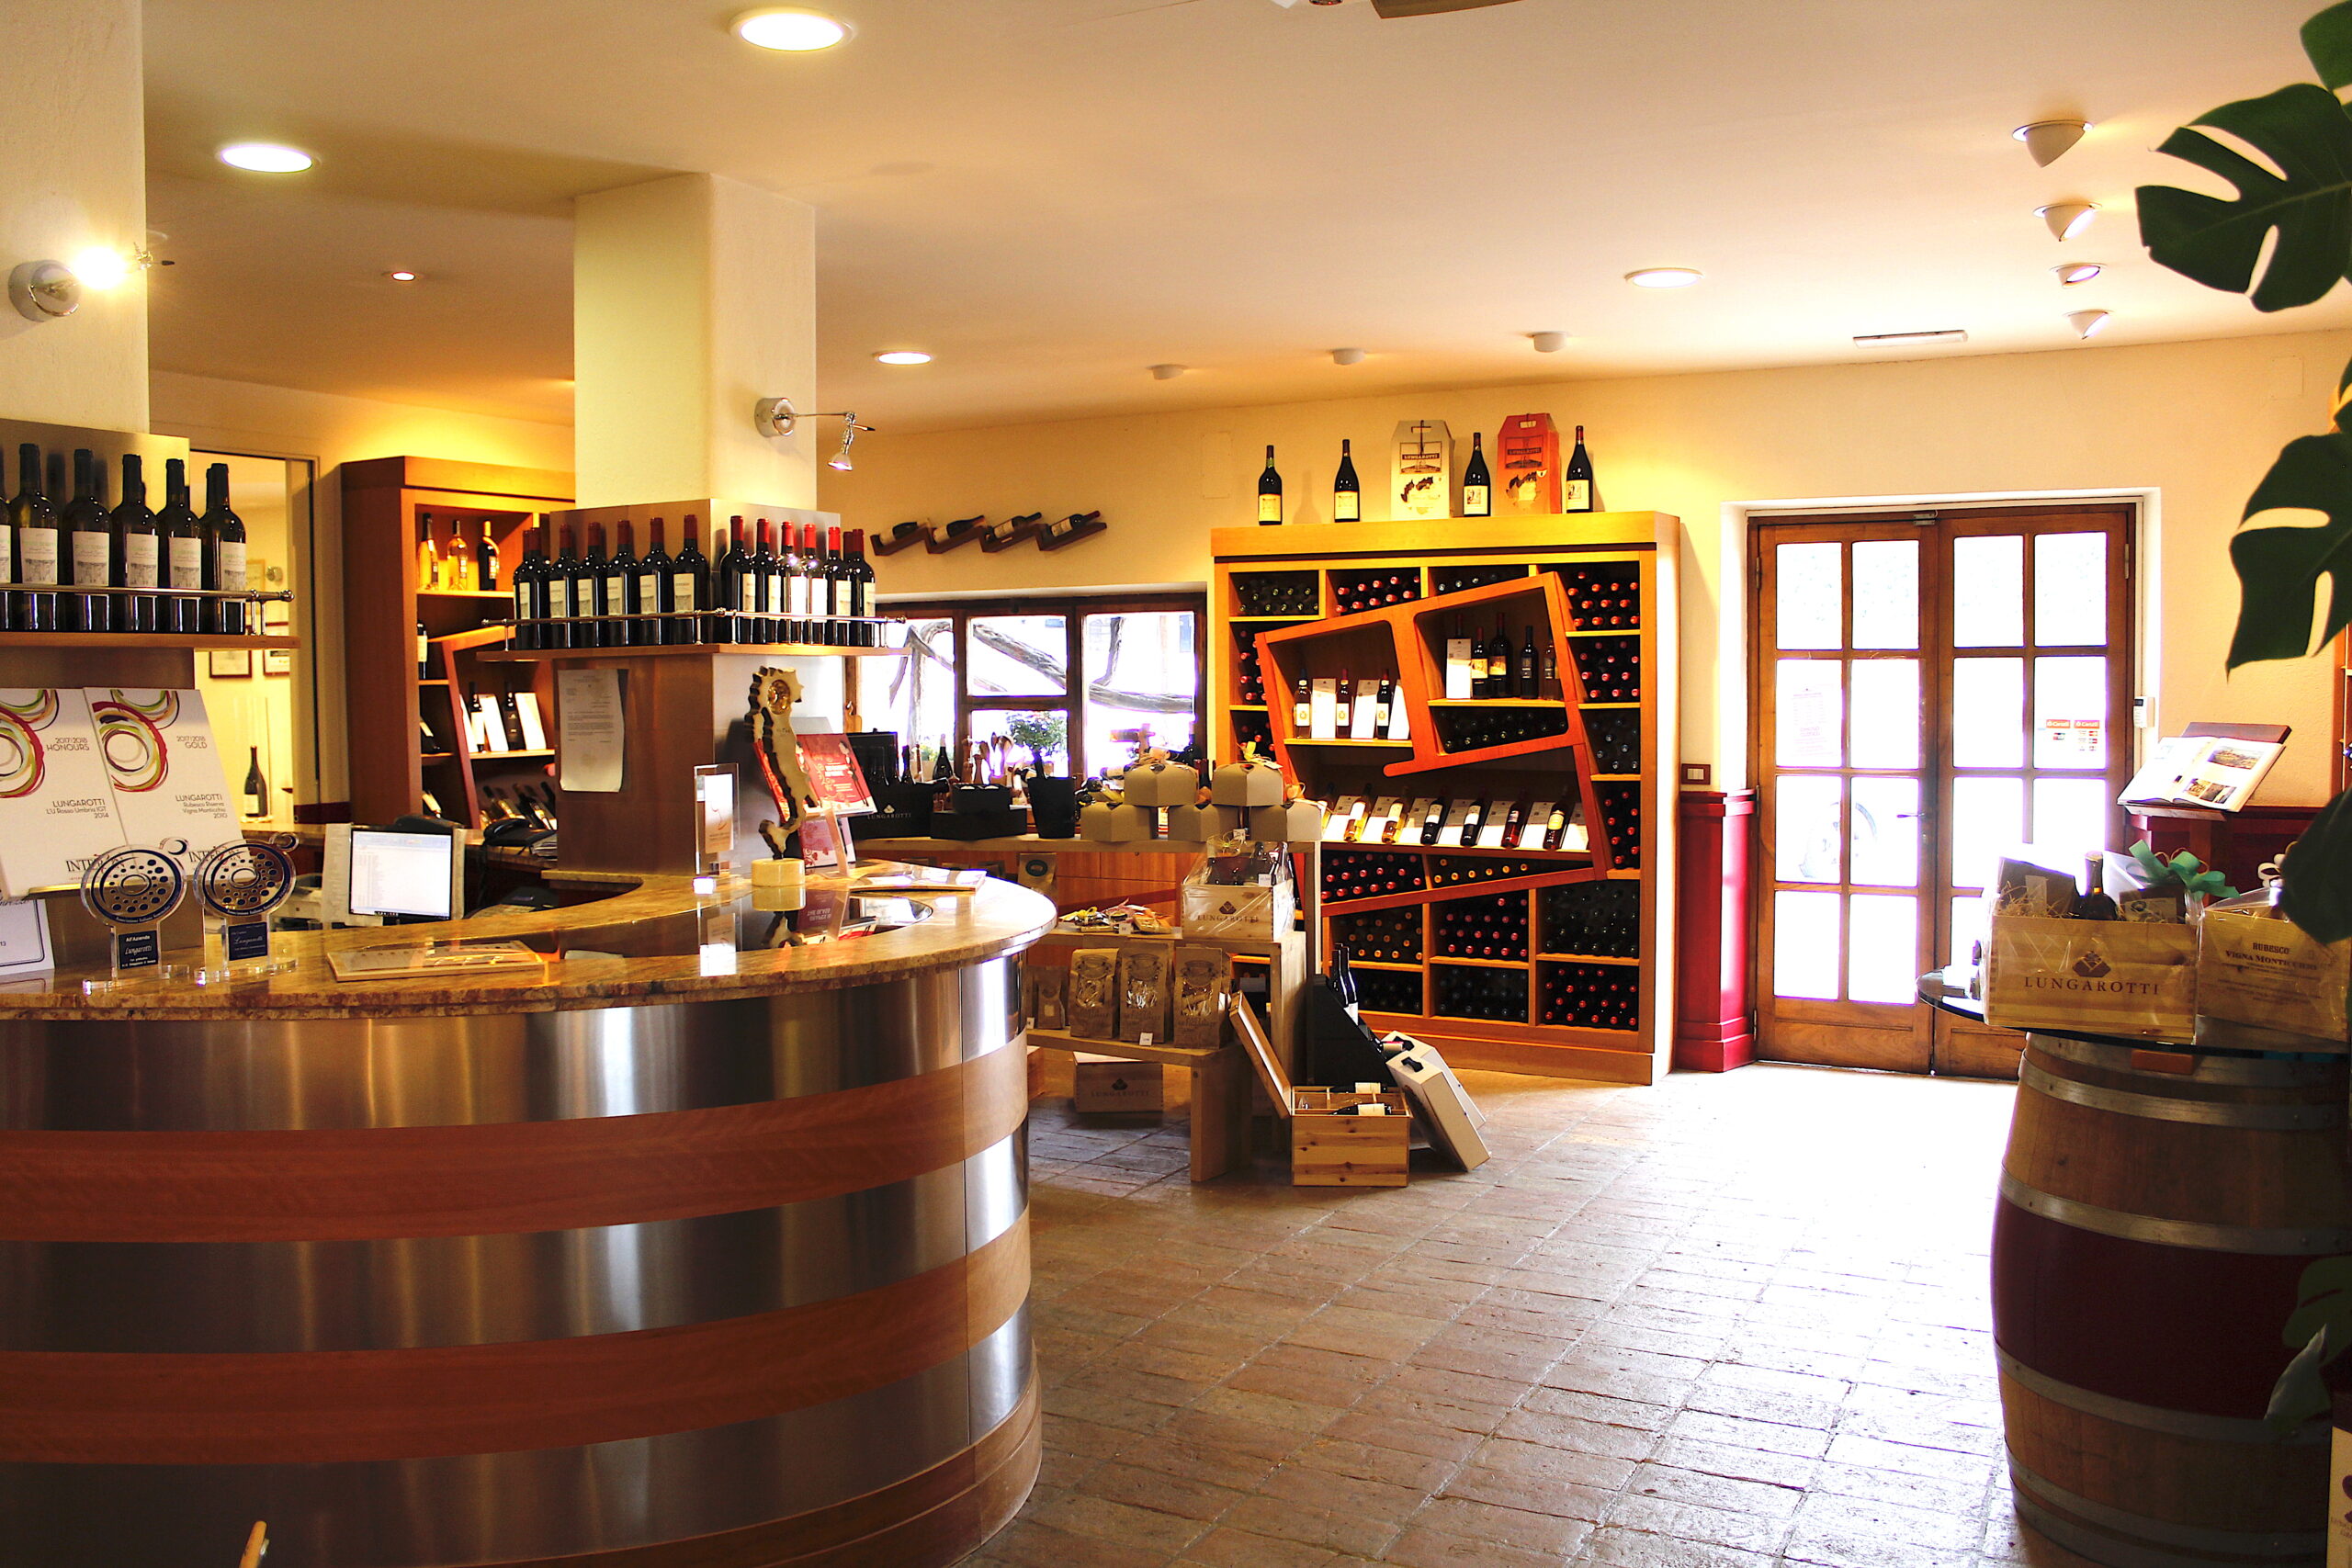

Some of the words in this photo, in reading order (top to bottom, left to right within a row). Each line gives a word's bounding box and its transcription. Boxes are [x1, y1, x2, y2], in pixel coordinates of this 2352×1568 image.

[52, 798, 106, 807] LUNGAROTTI
[175, 794, 222, 802] LUNGAROTTI
[2252, 942, 2290, 955] RUBESCO
[2025, 976, 2159, 995] LUNGAROTTI
